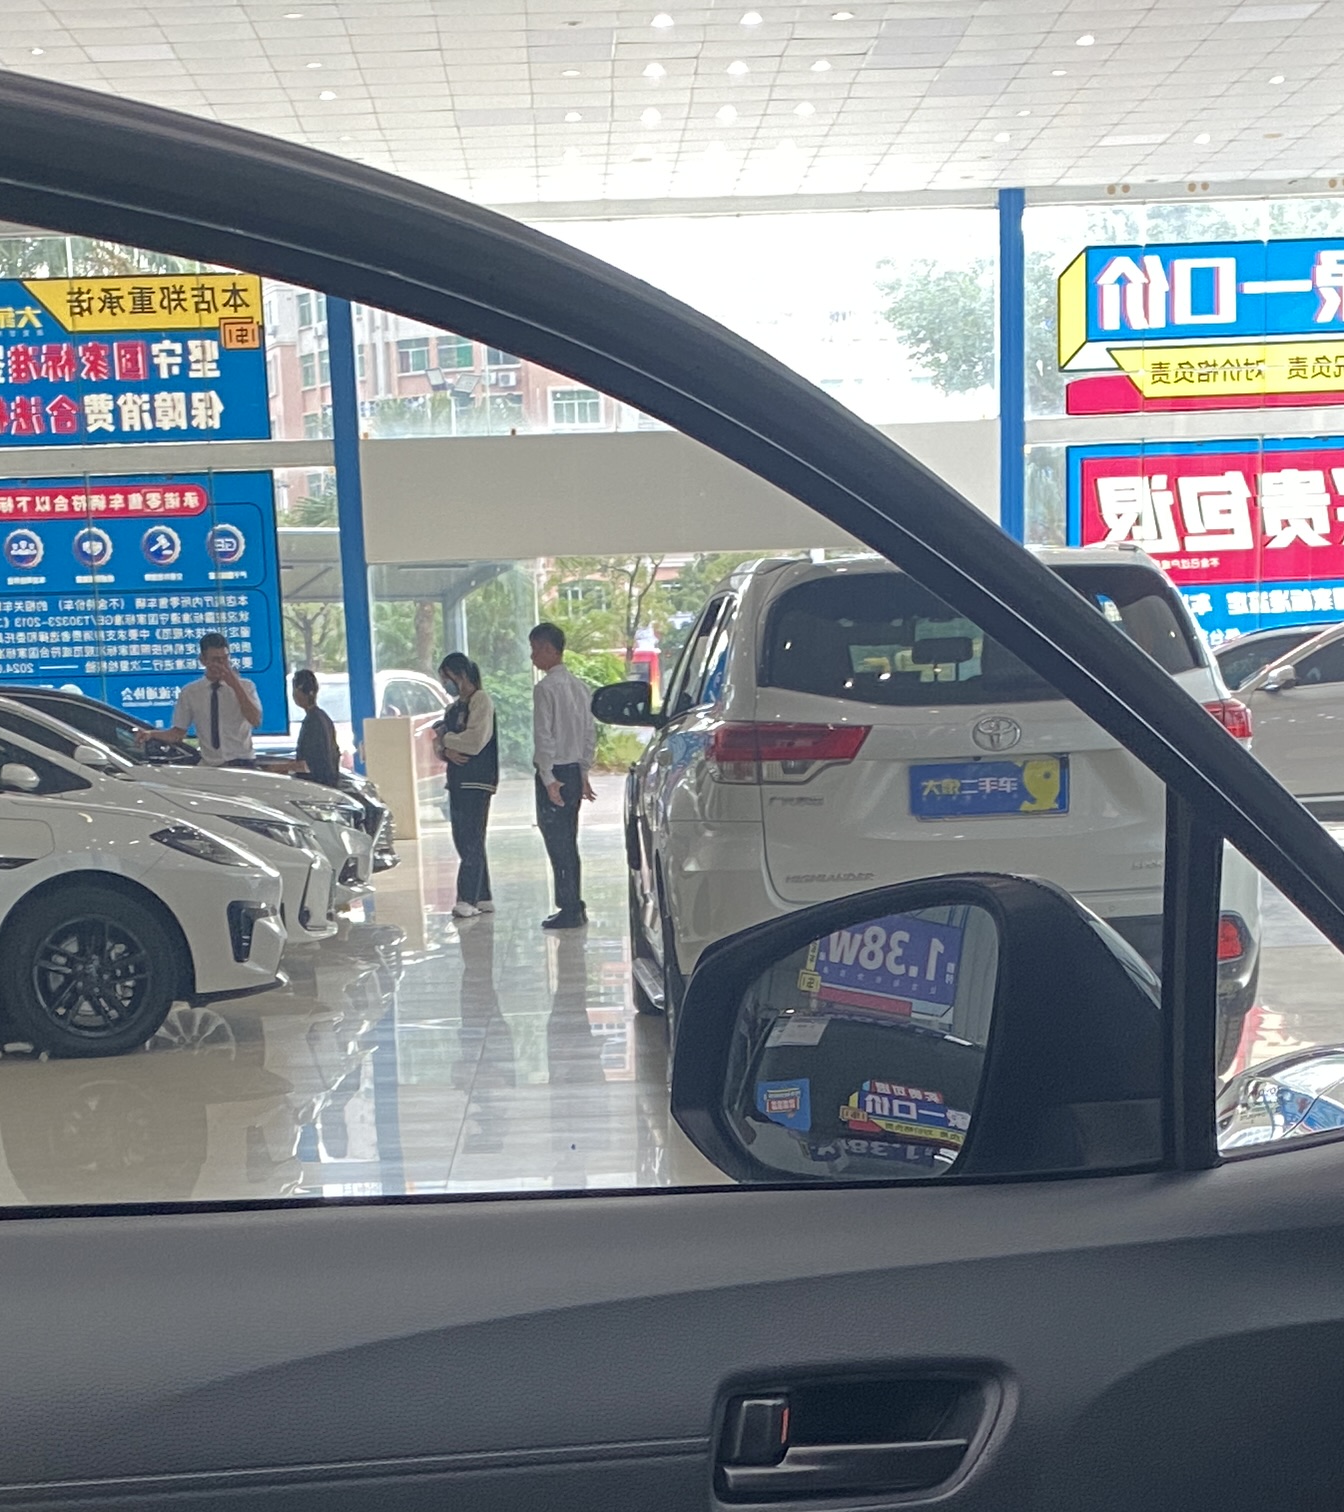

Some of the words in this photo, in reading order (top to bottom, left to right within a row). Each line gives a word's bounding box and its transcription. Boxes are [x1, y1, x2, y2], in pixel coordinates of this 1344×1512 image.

[921, 777, 1018, 796] 大象二手车
